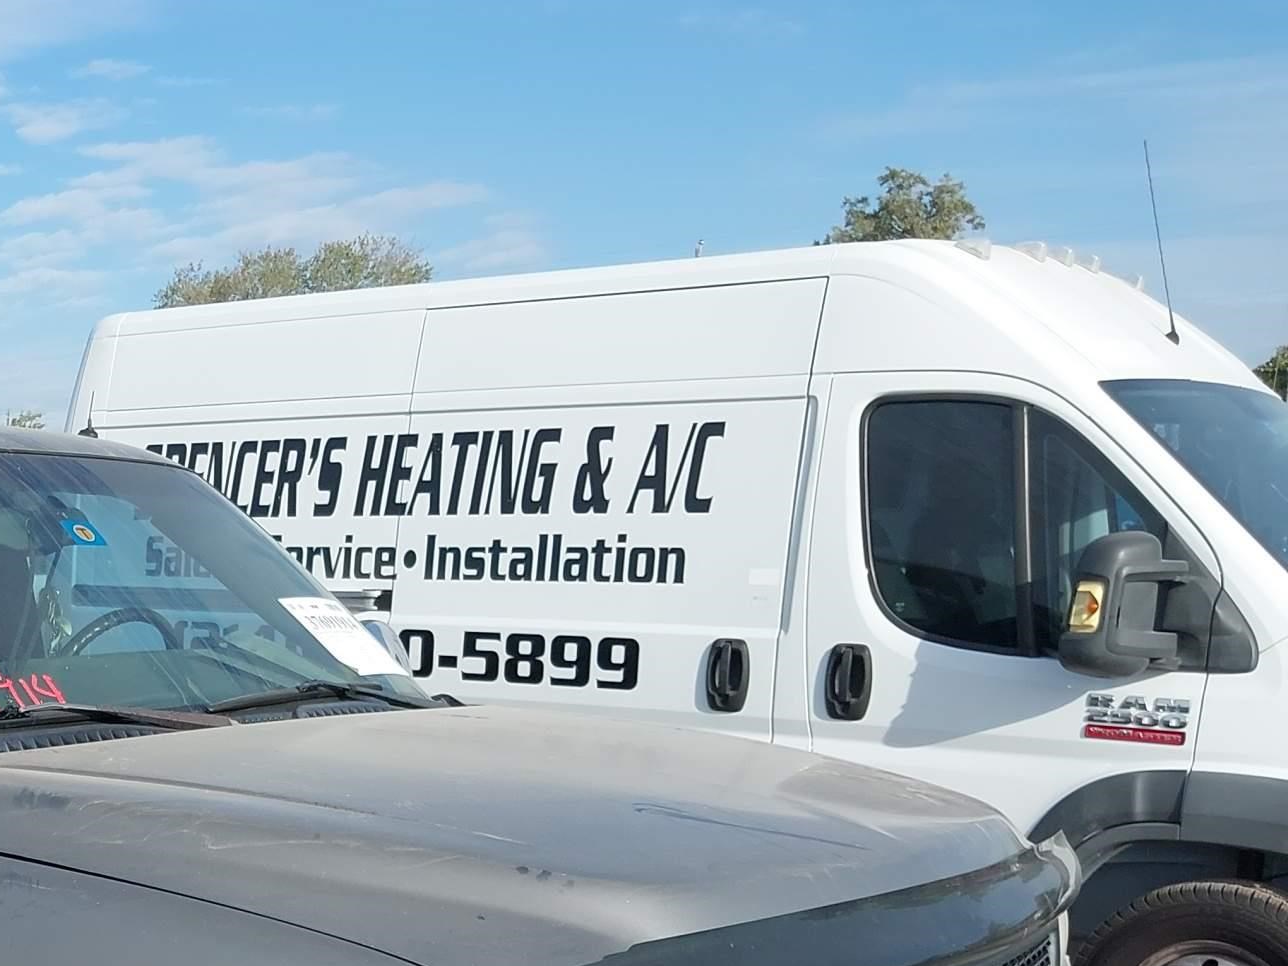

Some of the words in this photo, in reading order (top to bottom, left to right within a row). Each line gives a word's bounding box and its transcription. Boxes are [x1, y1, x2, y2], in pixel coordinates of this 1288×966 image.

[146, 437, 348, 517] NCER'S
[353, 428, 562, 516] HEATING
[572, 425, 615, 514] &
[625, 421, 726, 513] A/C
[145, 536, 212, 577] Sal
[272, 535, 397, 580] rvice
[423, 534, 686, 584] Installation
[1087, 693, 1190, 713] RAM
